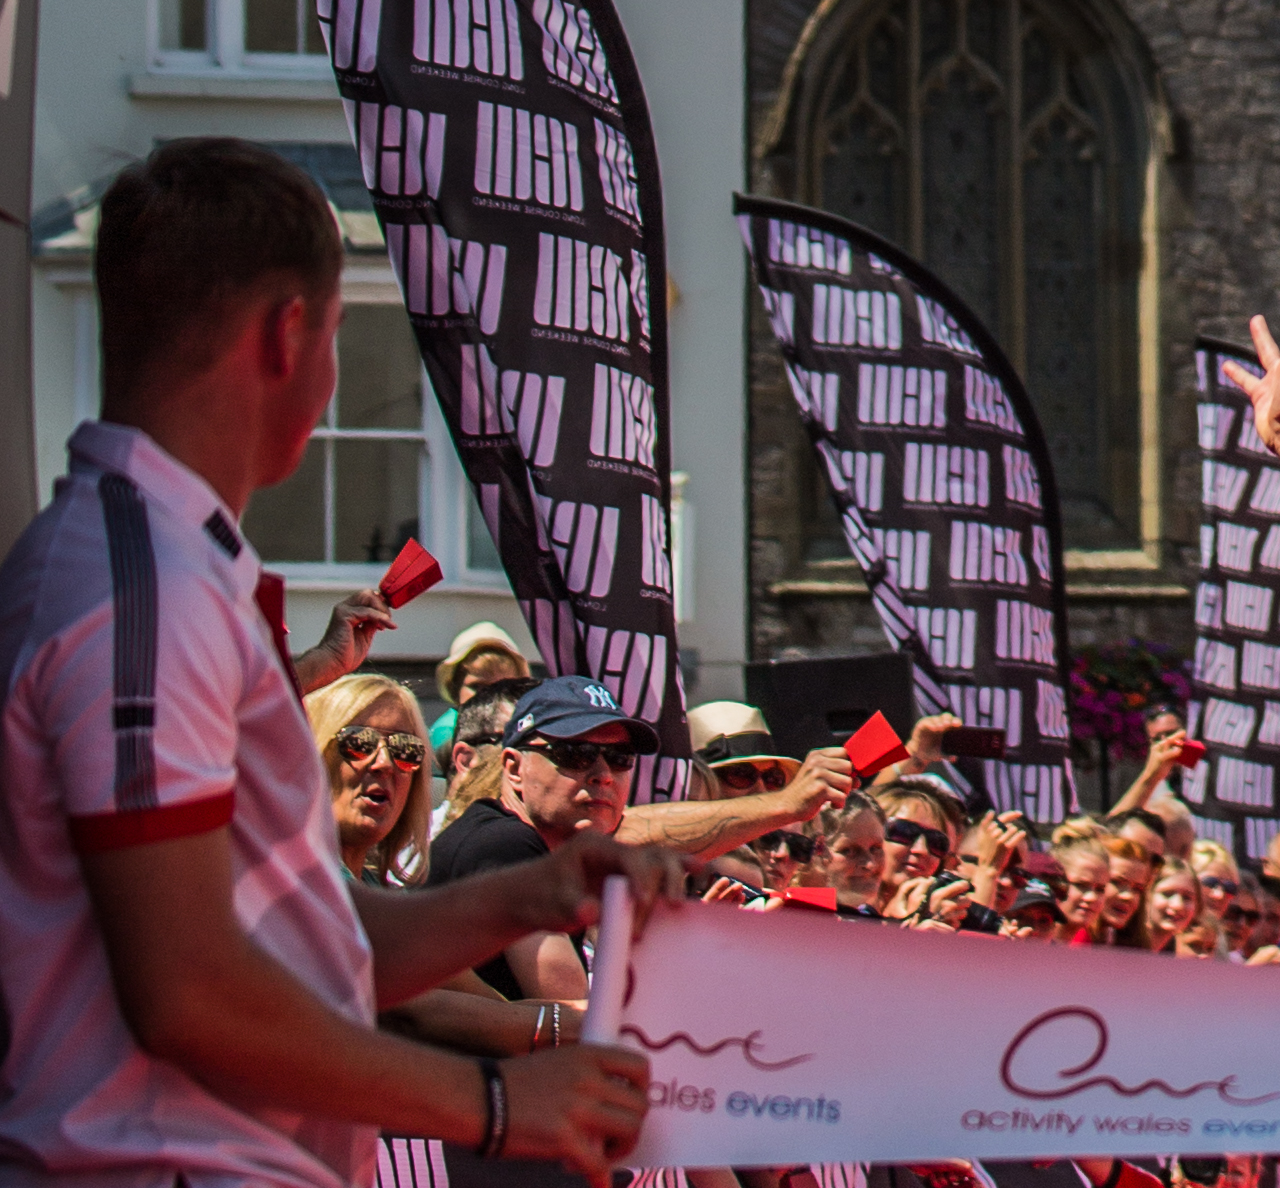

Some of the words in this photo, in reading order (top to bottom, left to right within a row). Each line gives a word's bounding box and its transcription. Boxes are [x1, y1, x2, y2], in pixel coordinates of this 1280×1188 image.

[648, 1076, 717, 1113] ales
[725, 1089, 842, 1124] events
[960, 1107, 1085, 1137] activity
[1092, 1111, 1193, 1137] wales
